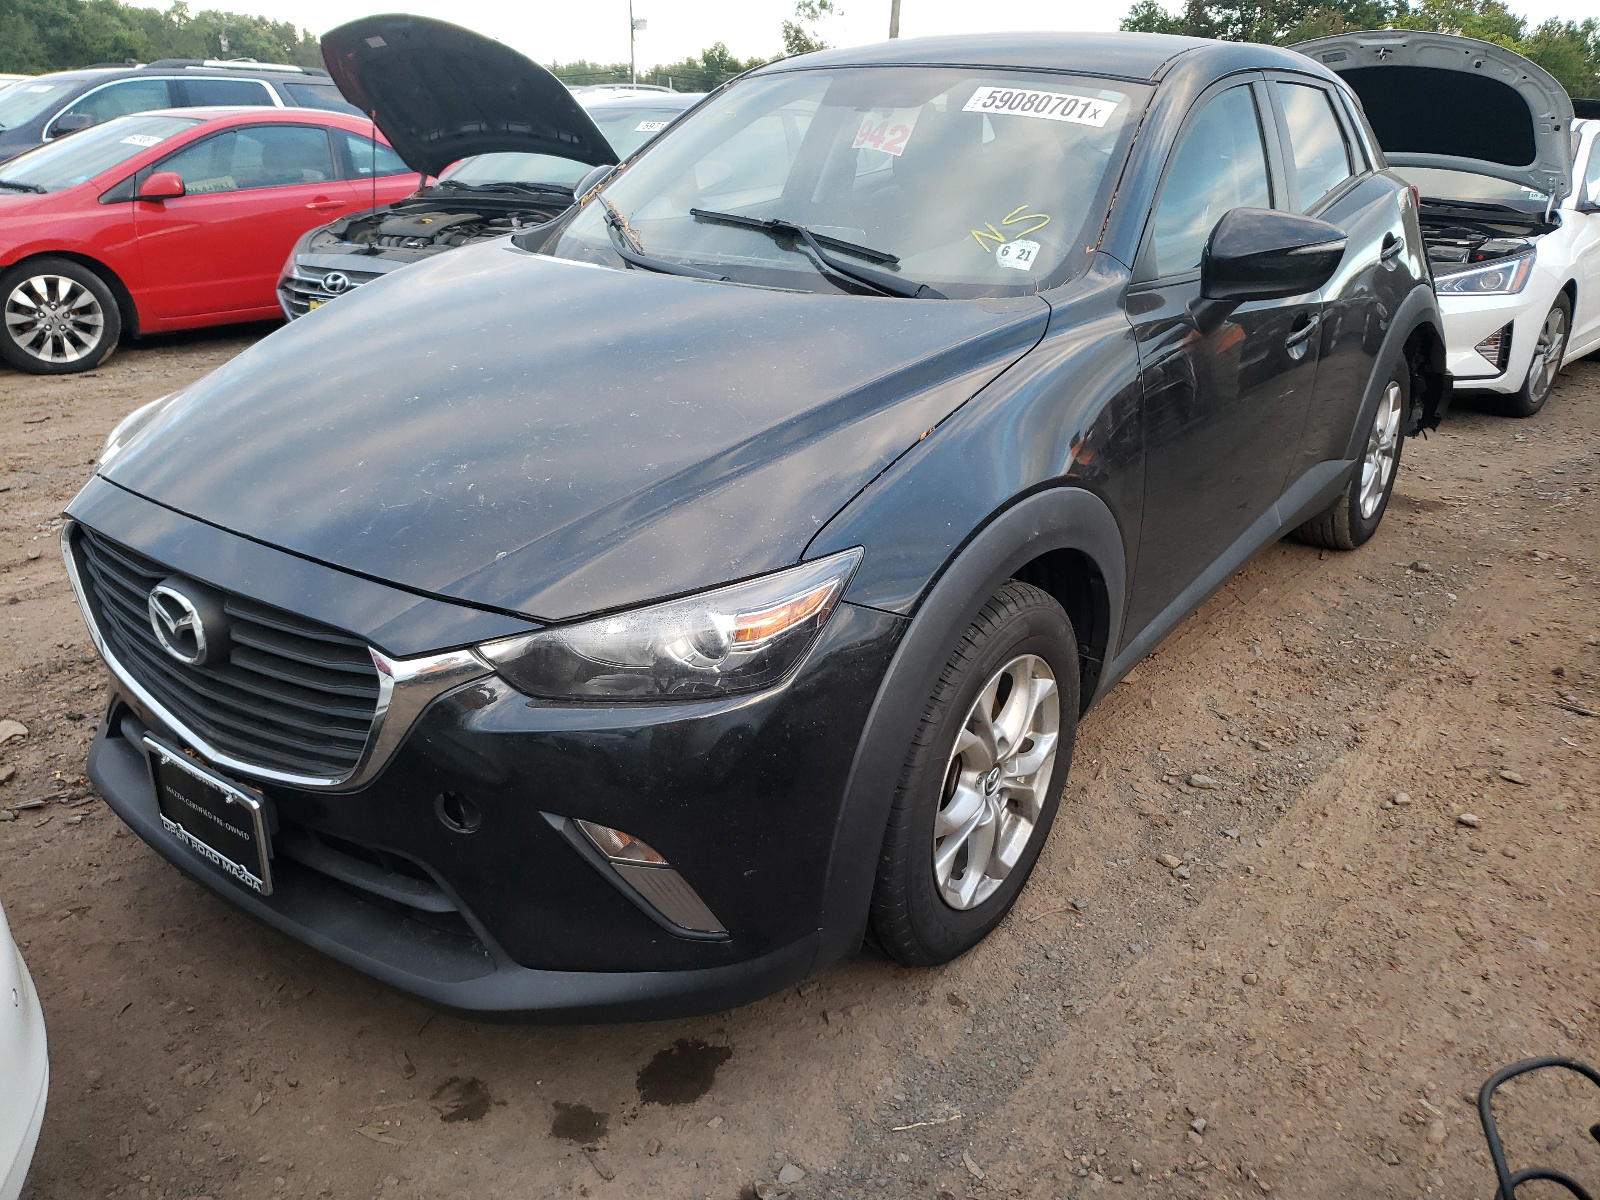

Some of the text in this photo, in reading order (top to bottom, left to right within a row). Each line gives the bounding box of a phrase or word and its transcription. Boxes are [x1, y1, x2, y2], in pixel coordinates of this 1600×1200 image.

[854, 119, 911, 153] 942
[1001, 245, 1032, 261] 6 21
[185, 798, 213, 820] CERTIFIED
[163, 820, 262, 893] OPEN ROAD MAZDA
